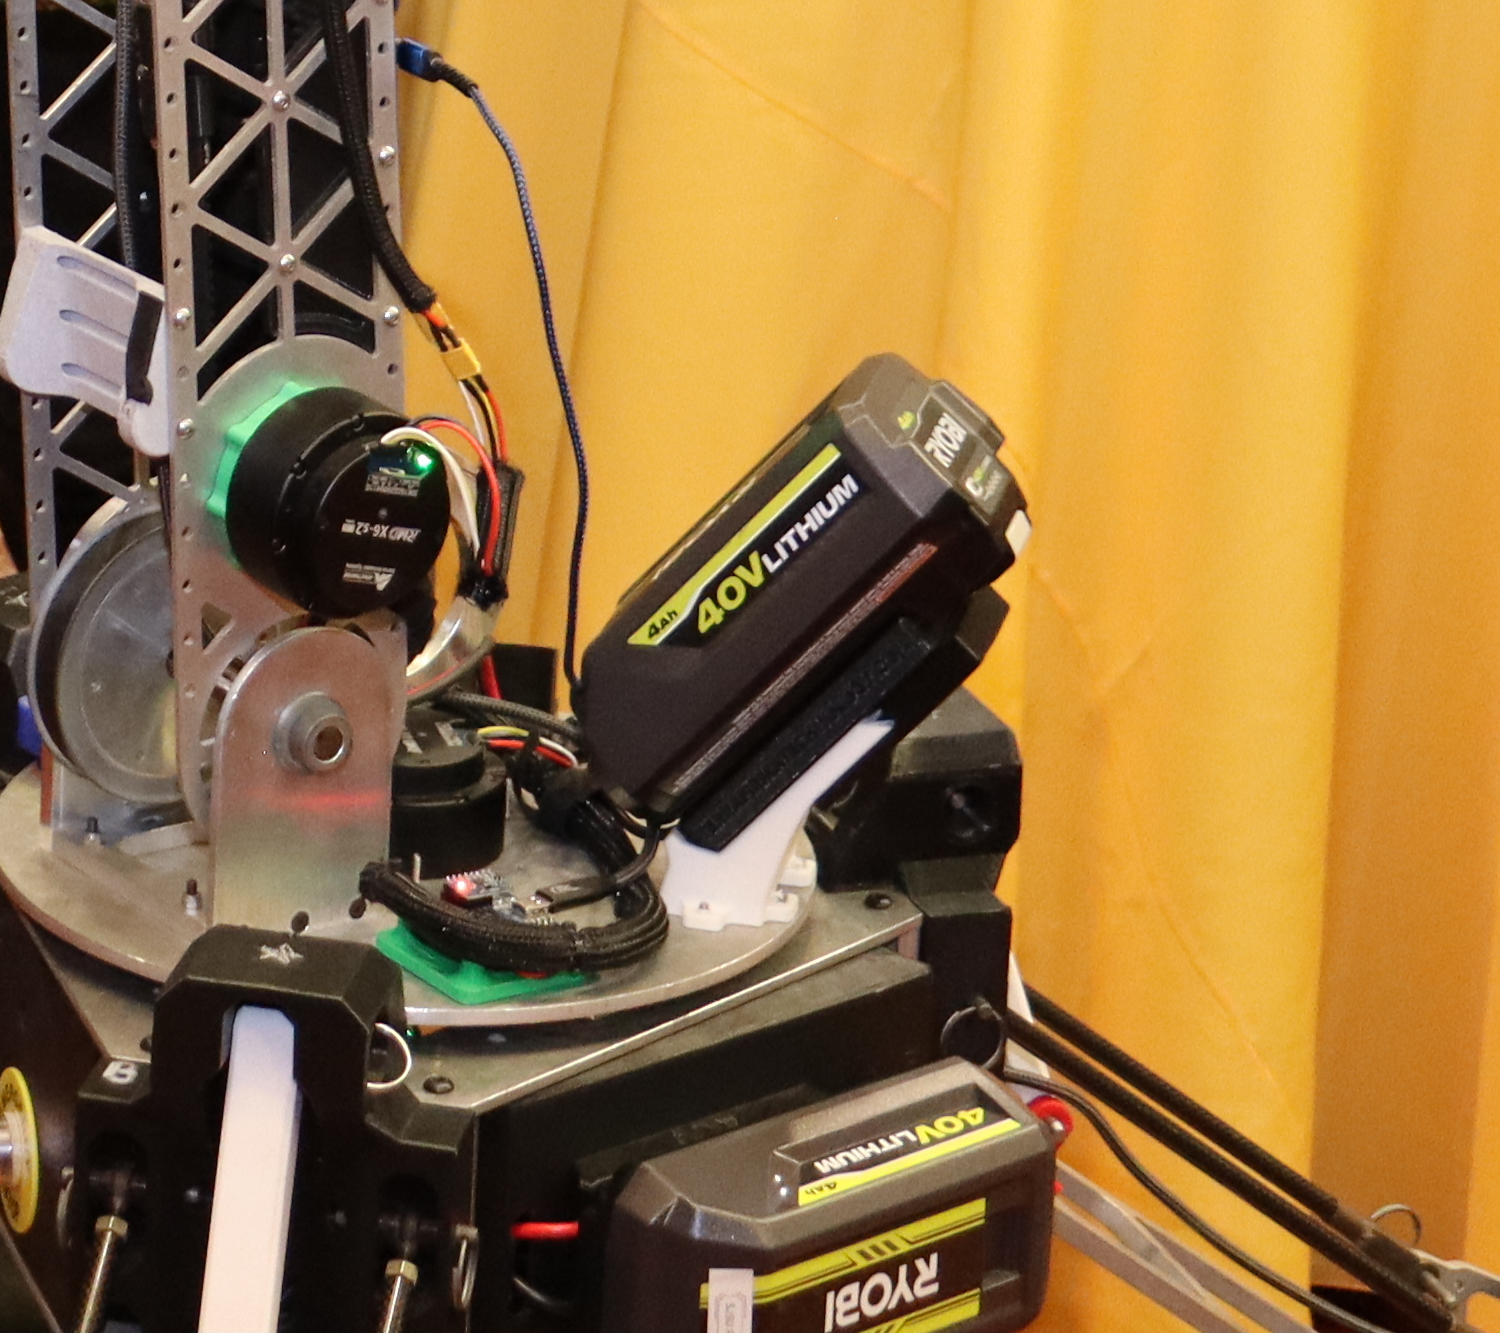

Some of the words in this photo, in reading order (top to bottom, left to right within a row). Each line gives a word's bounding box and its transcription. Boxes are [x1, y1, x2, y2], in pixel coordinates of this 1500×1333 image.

[922, 411, 969, 469] RYOBI
[695, 550, 767, 635] 40V
[760, 473, 861, 576] LITHIUM
[646, 607, 679, 642] 4Ah
[813, 1128, 917, 1174] LITHIUM
[913, 1105, 986, 1145] 40V
[824, 1252, 939, 1333] RYOBI
